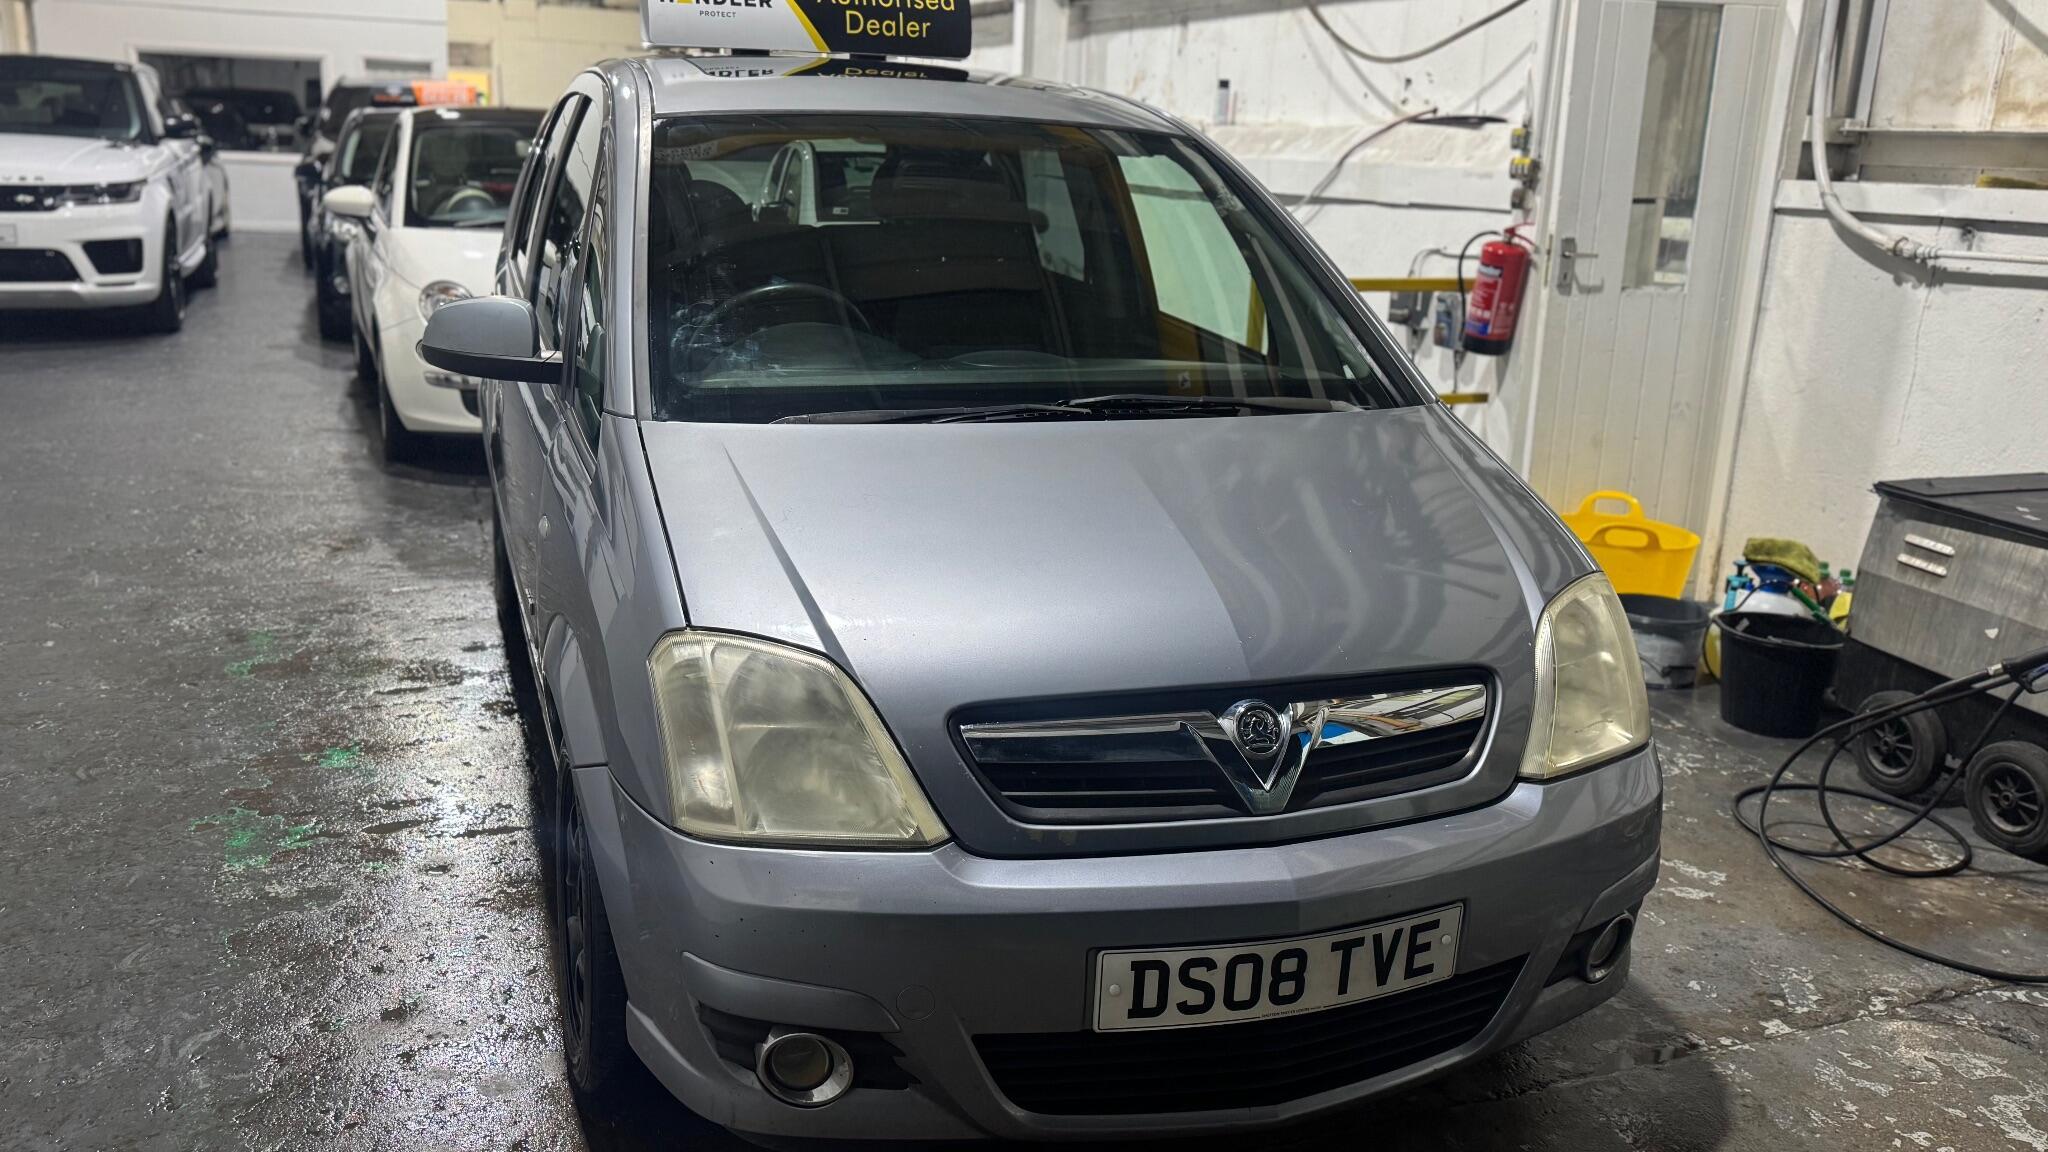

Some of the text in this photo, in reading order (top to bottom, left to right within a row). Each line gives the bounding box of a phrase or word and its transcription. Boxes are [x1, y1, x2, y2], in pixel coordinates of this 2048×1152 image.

[699, 10, 737, 18] PROTECT
[845, 10, 932, 38] Dealer
[1127, 919, 1441, 1019] DS08 TVE
